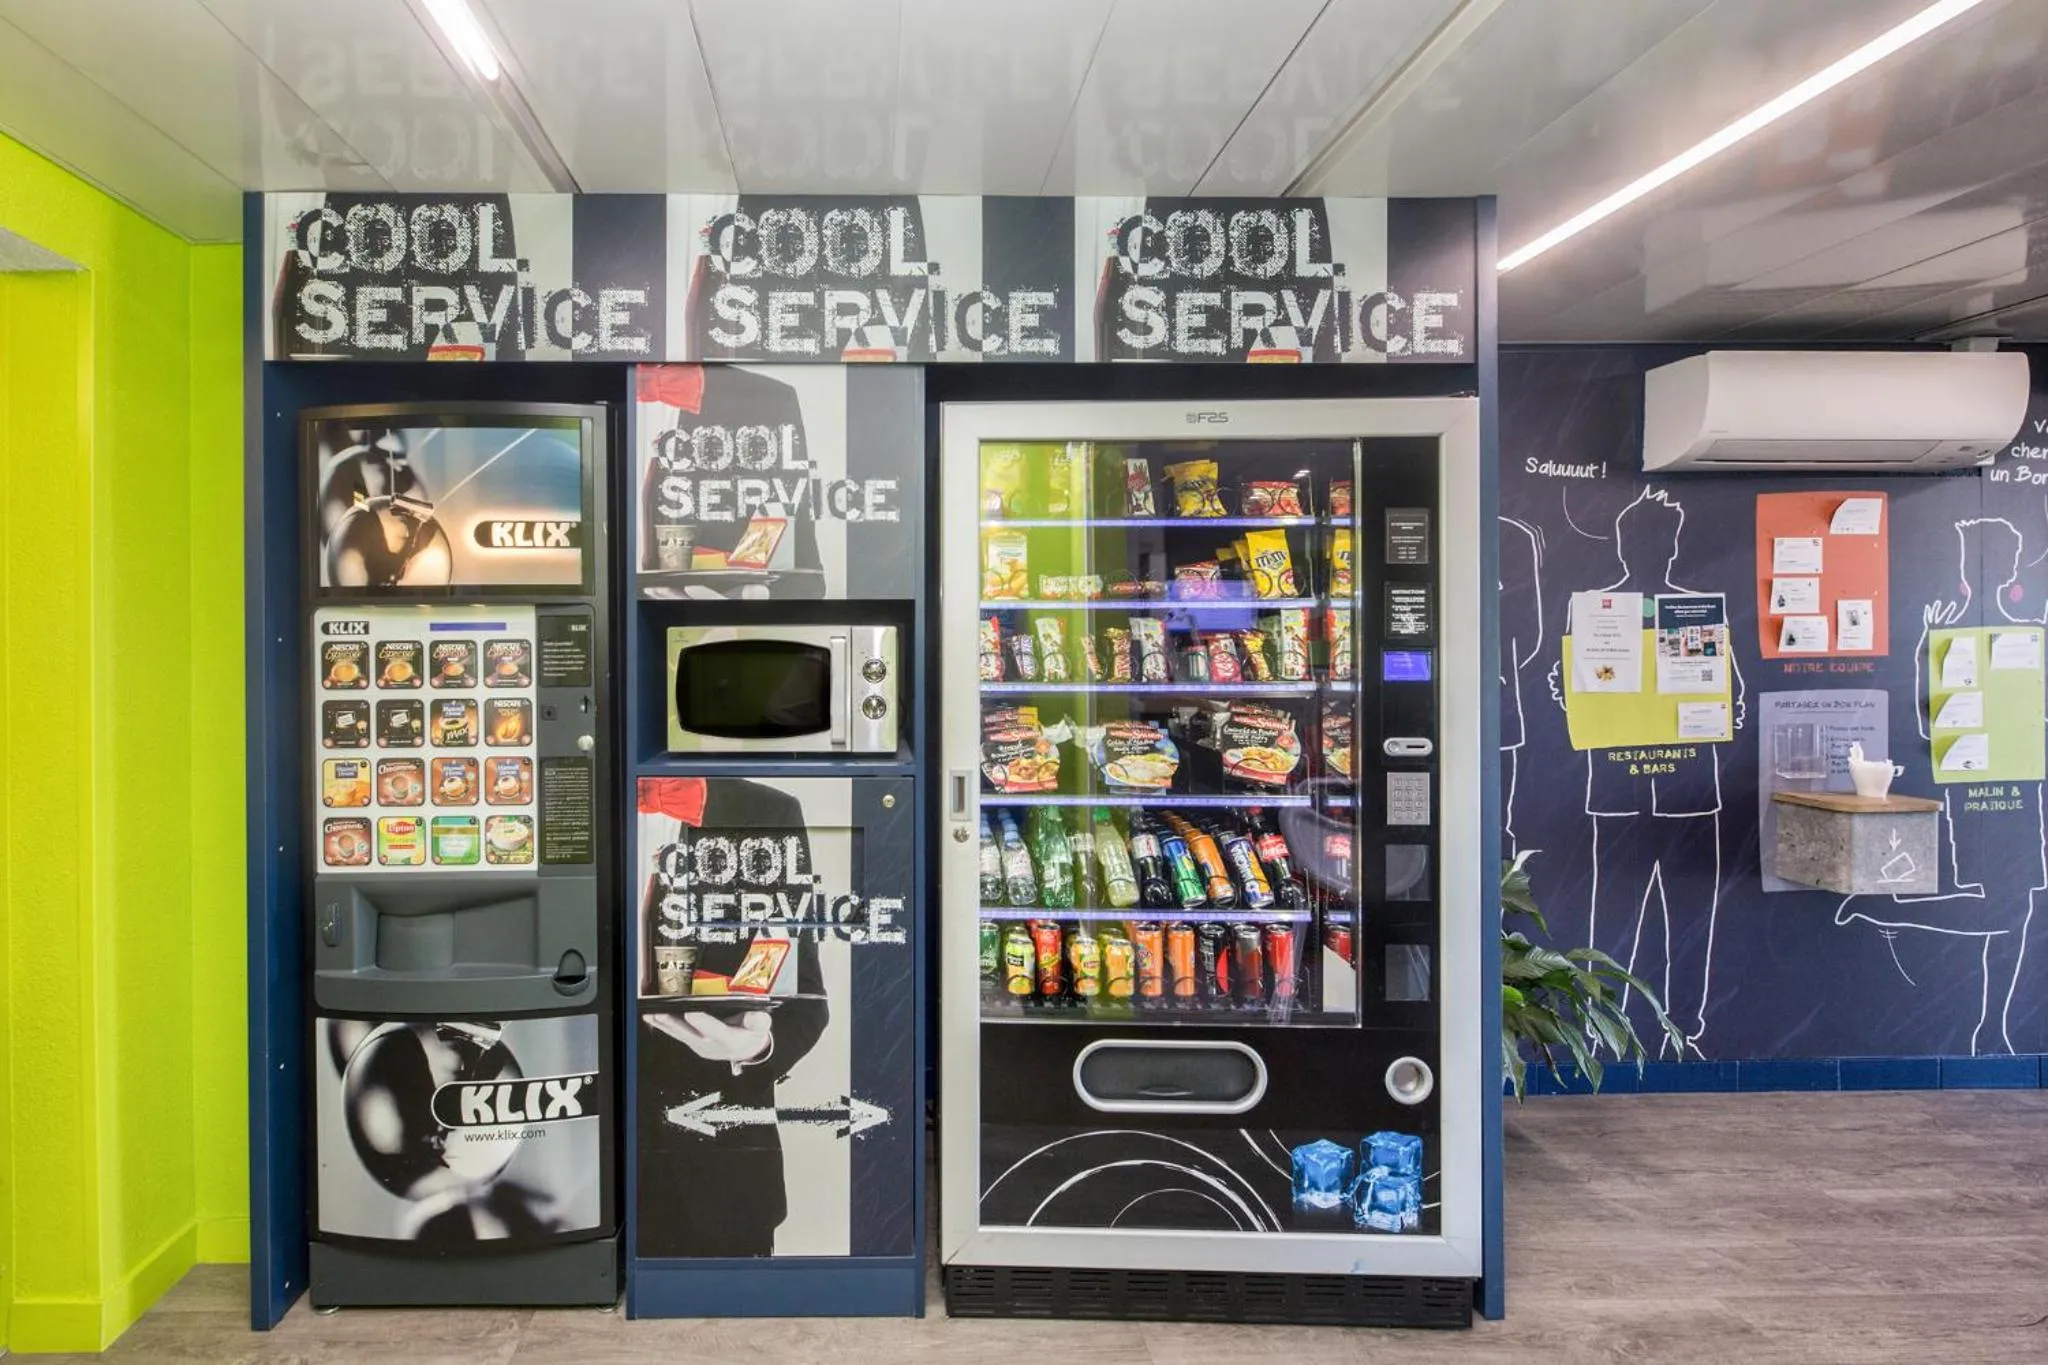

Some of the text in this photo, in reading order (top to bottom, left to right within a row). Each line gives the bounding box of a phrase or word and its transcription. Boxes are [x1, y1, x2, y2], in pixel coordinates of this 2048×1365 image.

[295, 279, 652, 353] SERVICE
[708, 283, 1061, 355] SERVICE
[1116, 284, 1465, 356] SERVICE
[1990, 469, 2010, 483] un
[656, 475, 901, 523] SERVICE
[491, 522, 571, 547] KLIX
[328, 621, 366, 635] KLIX
[1608, 748, 1697, 761] RESTAURANTS
[1629, 763, 1676, 775] & BARS
[1968, 786, 2020, 798] MALIN &
[1964, 799, 2023, 812] PRATIQUE
[657, 890, 907, 945] SERVICE
[460, 1077, 584, 1125] KLIX
[464, 1127, 546, 1142] www.klix.com
